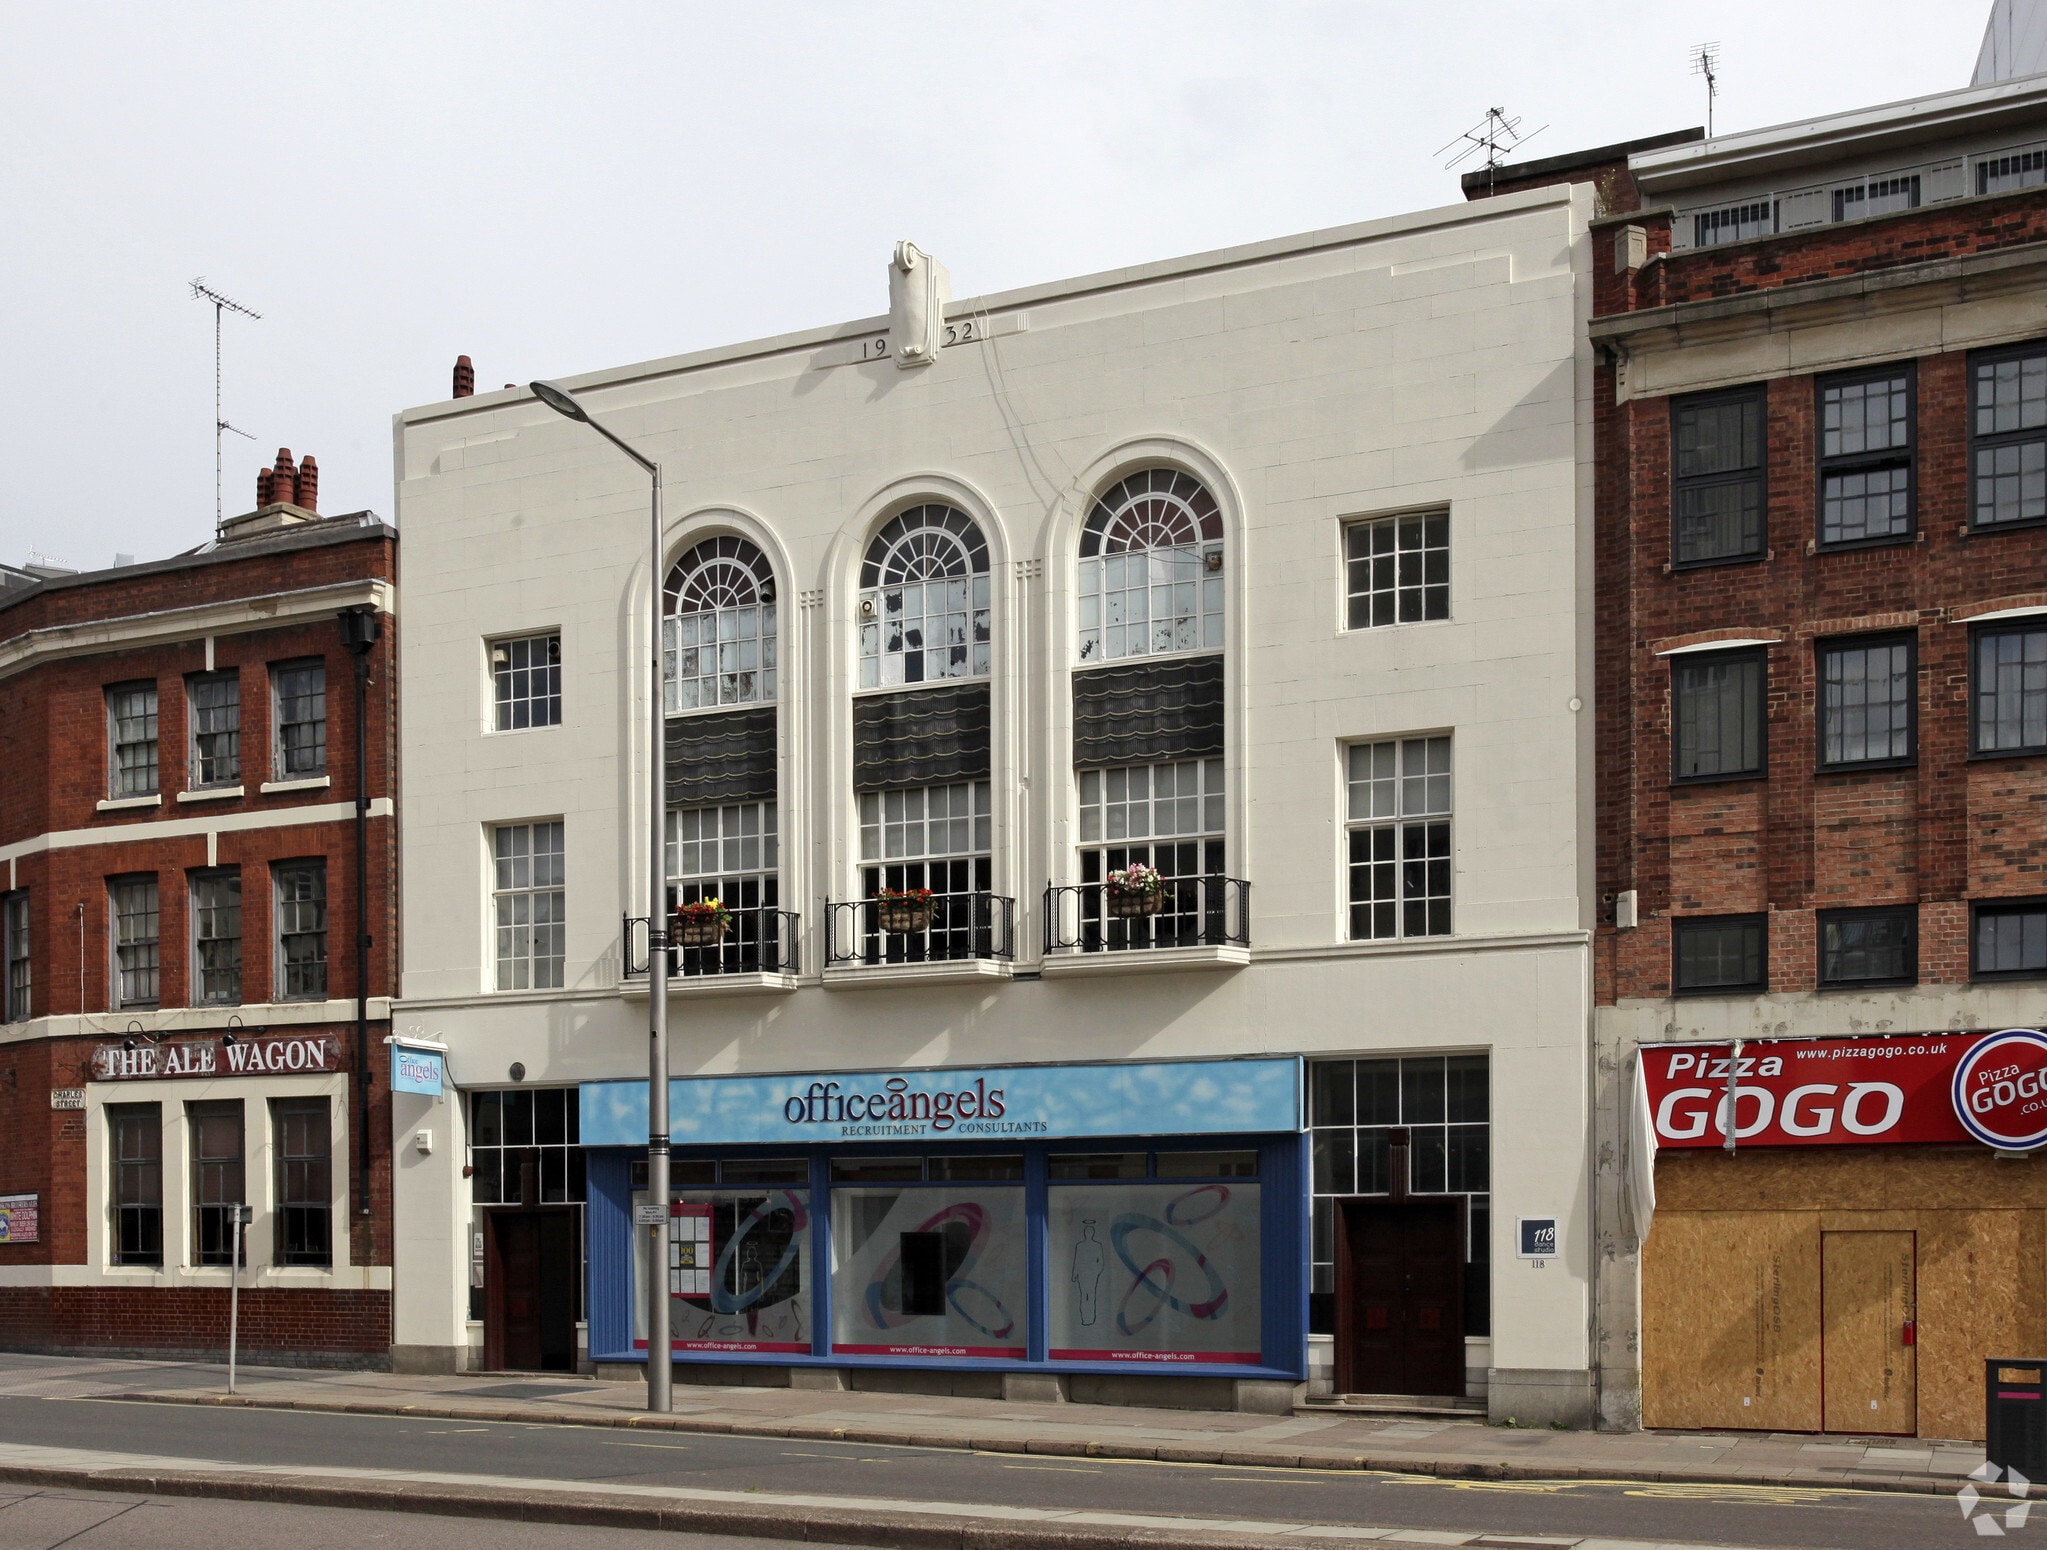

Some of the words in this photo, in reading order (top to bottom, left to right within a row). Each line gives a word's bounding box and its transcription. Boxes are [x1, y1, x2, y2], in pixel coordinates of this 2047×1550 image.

[103, 1048, 156, 1076] THE
[164, 1045, 217, 1075] ALE
[226, 1039, 327, 1073] WAGON
[1795, 1042, 1948, 1060] www.pizzagogo.co.uk
[400, 1061, 439, 1083] angels
[1665, 1052, 1784, 1080] Pizza
[1978, 1064, 2020, 1085] Pizza
[53, 1090, 83, 1099] CHARLES
[56, 1100, 81, 1108] STREET
[1655, 1081, 1905, 1141] GOGO
[841, 1123, 927, 1137] RECRUITMENT
[958, 1121, 1048, 1135] CONSULTANTS
[1534, 1227, 1554, 1243] 118
[1532, 1259, 1545, 1269] 118
[686, 1341, 757, 1351] www.office-angels.com
[889, 1344, 967, 1355] www.office-angels.com
[1111, 1351, 1195, 1361] www.office-angels.com
